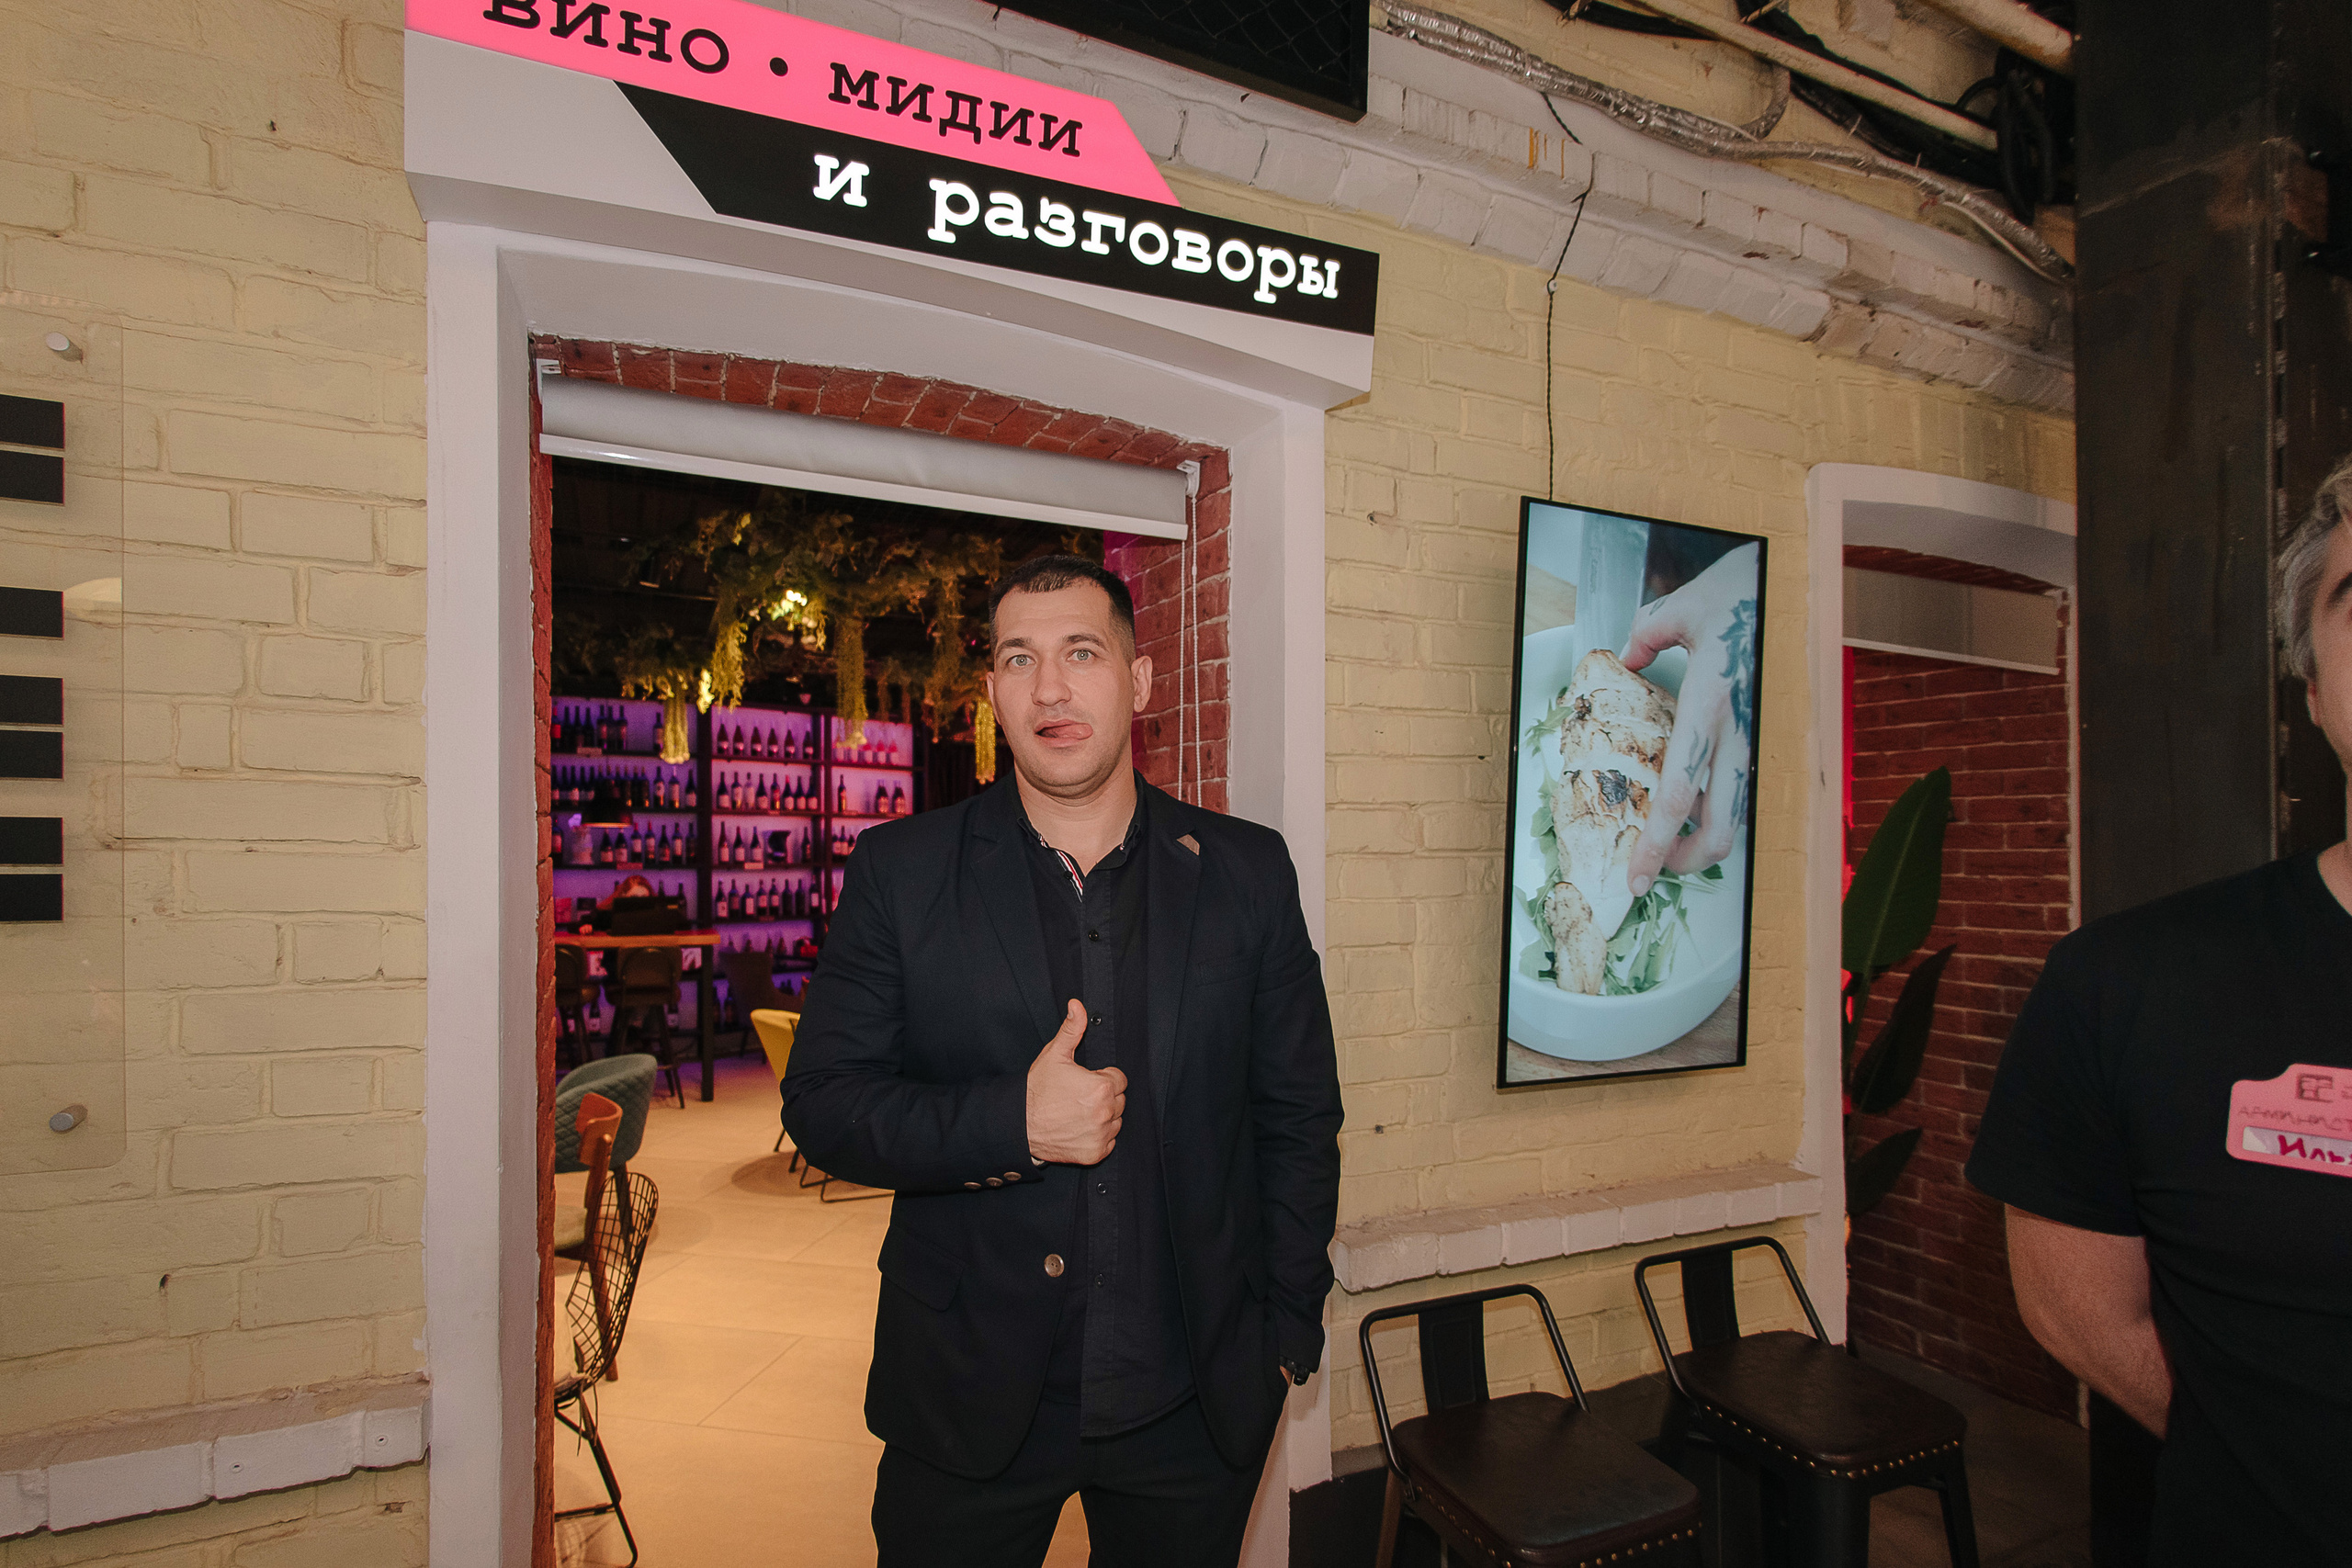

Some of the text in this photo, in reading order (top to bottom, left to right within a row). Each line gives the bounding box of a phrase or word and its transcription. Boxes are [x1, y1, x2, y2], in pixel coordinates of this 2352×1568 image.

[828, 62, 1083, 157] мидии
[813, 153, 1341, 304] и разговоры
[2278, 1134, 2352, 1165] Иль
